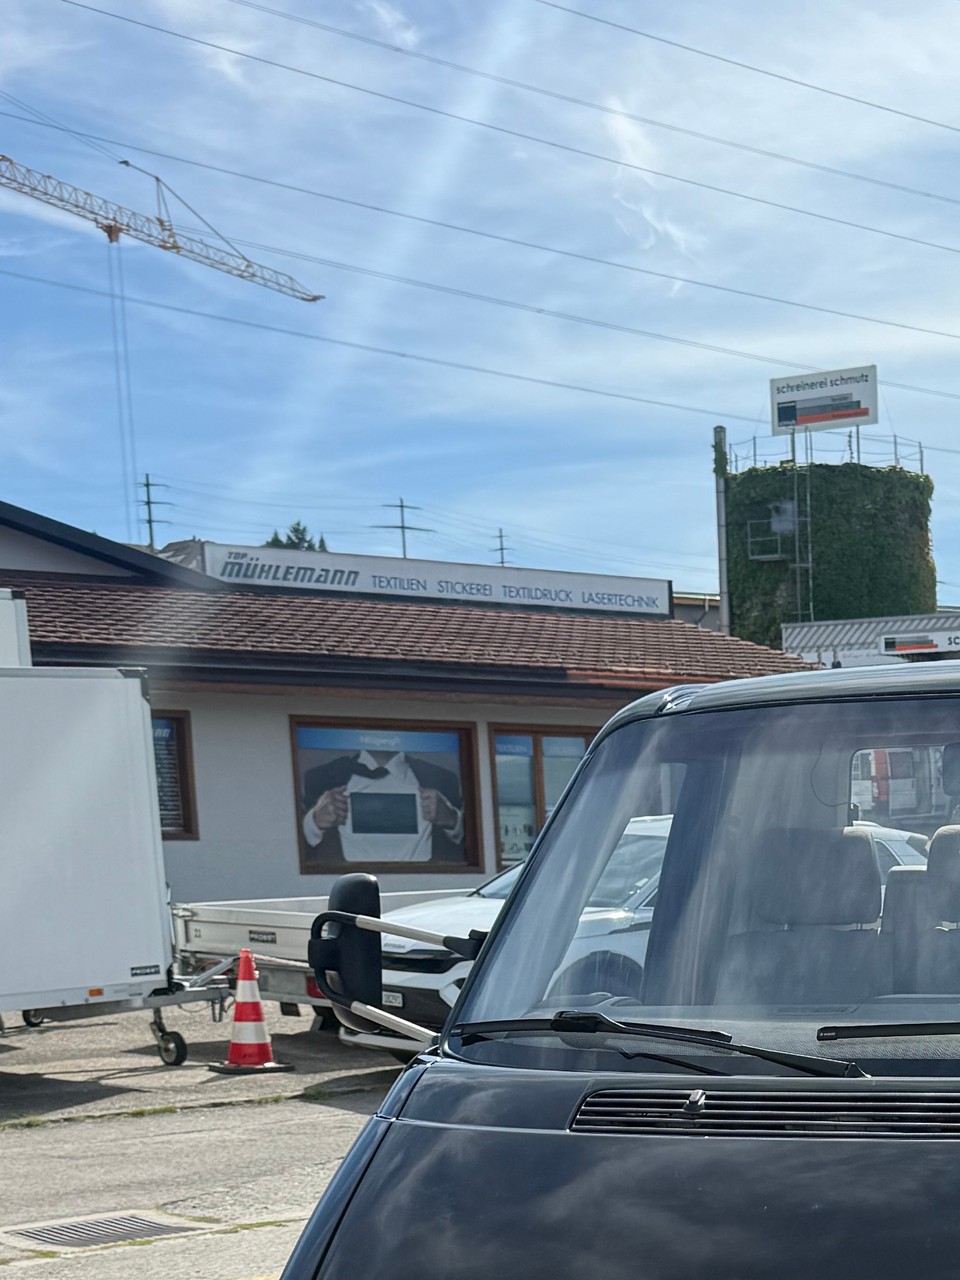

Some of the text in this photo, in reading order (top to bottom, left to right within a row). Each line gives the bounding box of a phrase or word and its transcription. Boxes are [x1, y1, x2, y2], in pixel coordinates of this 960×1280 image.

[776, 372, 869, 395] schreinerei schmutz
[227, 551, 248, 561] TOP
[371, 575, 659, 609] TEXTILIEN STICKEREI TEXTILDRUCK LASERTECHNIK
